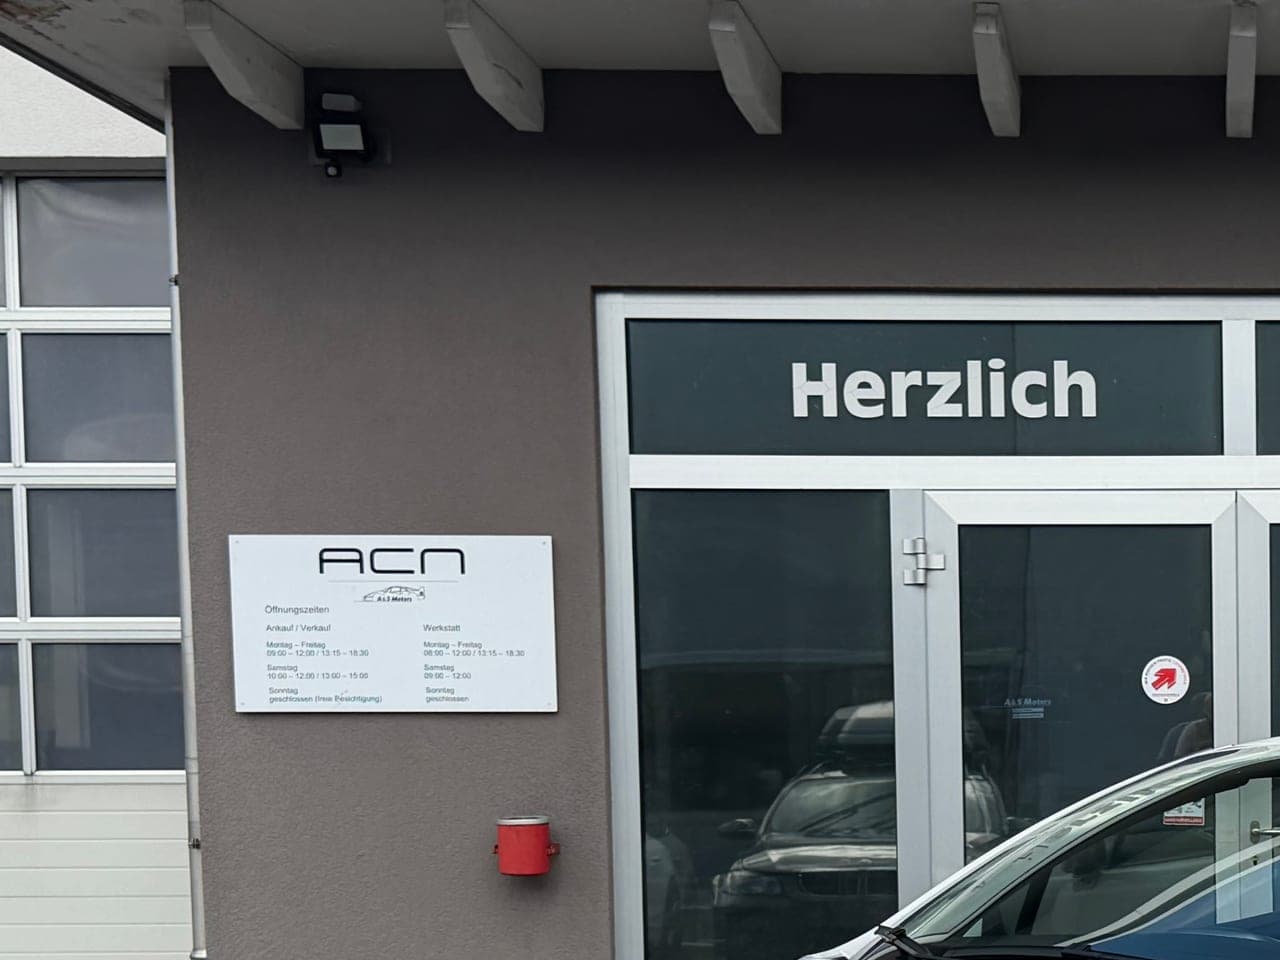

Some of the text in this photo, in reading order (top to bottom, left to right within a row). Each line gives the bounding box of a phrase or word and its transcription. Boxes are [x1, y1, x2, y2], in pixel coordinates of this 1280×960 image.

[791, 357, 1098, 419] Herzlich
[266, 624, 294, 632] Ankauf
[301, 624, 331, 632] Verkauf
[423, 624, 461, 632] Werkstatt
[266, 641, 293, 650] Montag
[301, 641, 326, 650] Freitag
[423, 641, 450, 650] Montag
[457, 641, 482, 650] Freitag
[267, 664, 298, 673] Samstag
[423, 664, 455, 673] Samstag
[268, 686, 299, 696] Sonntag
[425, 686, 455, 696] Sonntag
[269, 695, 314, 704] geschlossen
[425, 695, 470, 704] geschlossen
